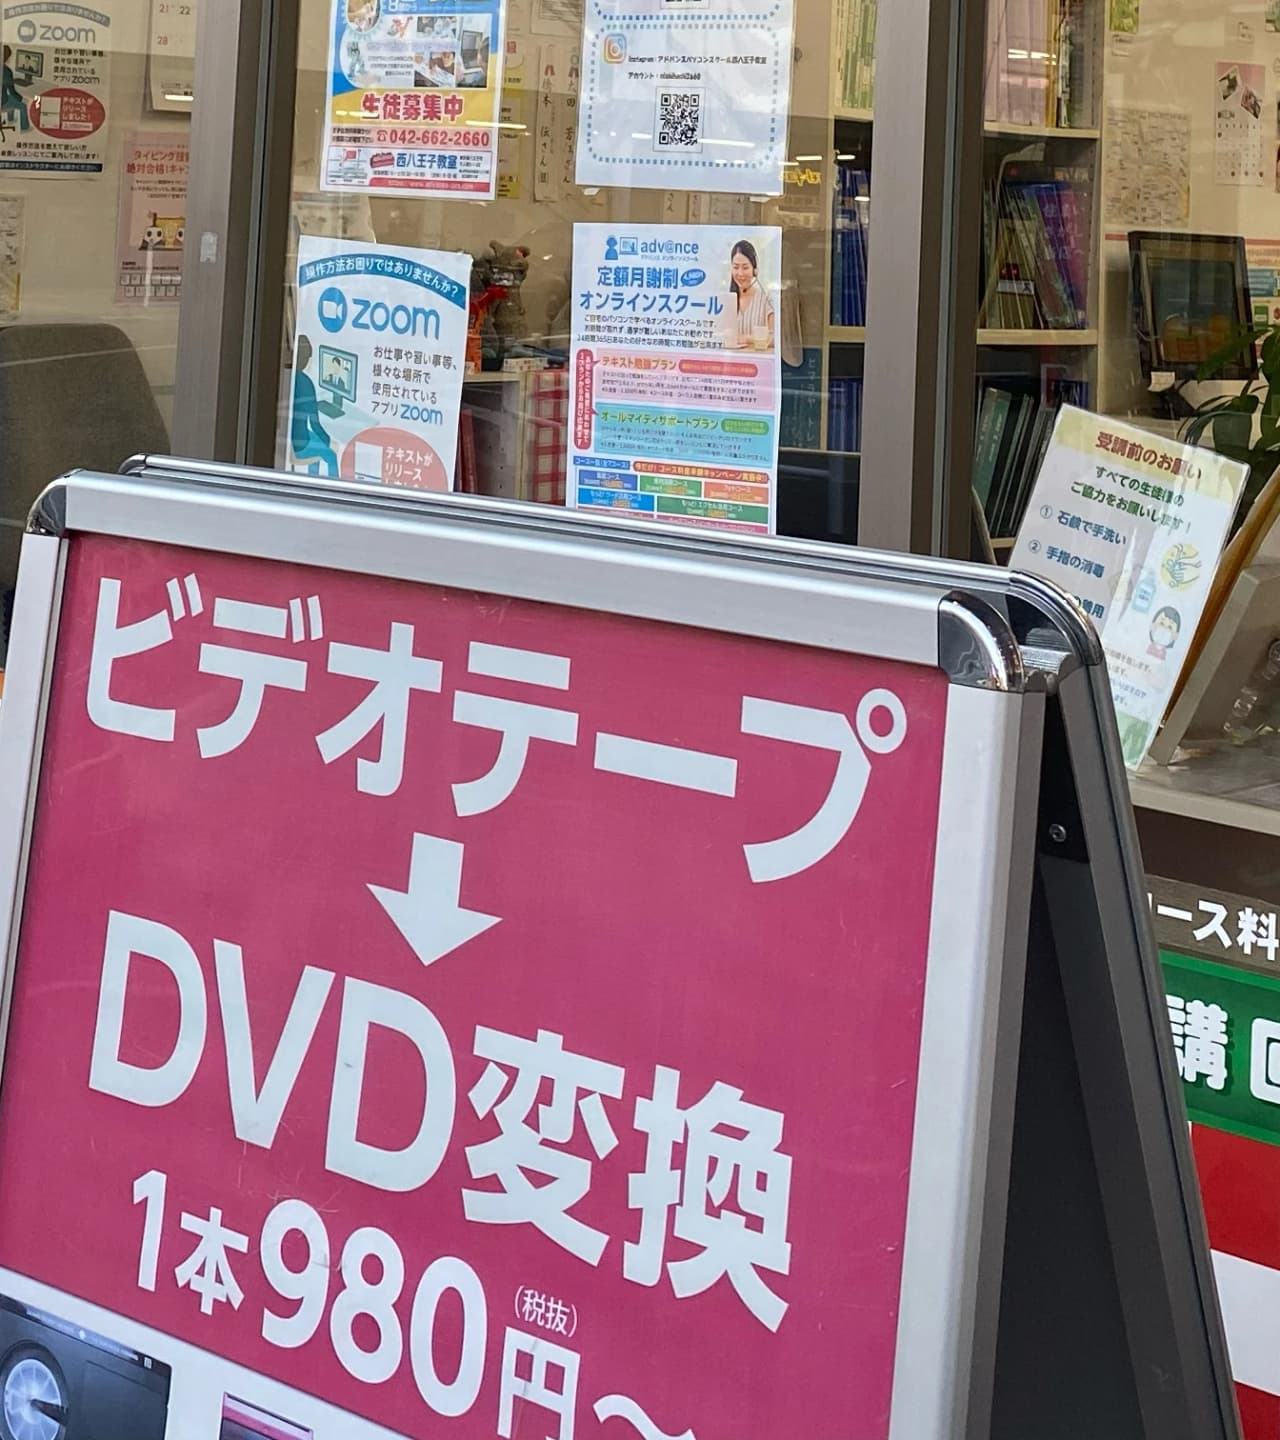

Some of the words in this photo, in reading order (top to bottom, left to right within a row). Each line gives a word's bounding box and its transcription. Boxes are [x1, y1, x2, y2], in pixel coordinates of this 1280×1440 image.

[40, 24, 96, 44] zoom
[362, 92, 464, 121] 生徒募集中
[389, 128, 490, 147] 042-662-2660
[396, 152, 458, 170] 西八王子教室
[640, 239, 700, 255] adv@nce
[304, 257, 460, 298] 操作方法お困りではありませんか?
[597, 265, 679, 289] 定額月謝制
[579, 290, 724, 315] オンラインスクール
[351, 297, 441, 341] zoom
[373, 346, 457, 372] お仕事や習い事等、
[372, 366, 432, 386] 様々な場所で
[371, 382, 438, 405] 使用されている
[600, 411, 719, 430] オールマイティサポートプラン
[385, 446, 434, 467] テキストが
[1095, 430, 1203, 481] 受講前のお願い
[385, 461, 422, 480] リリース
[1095, 464, 1185, 508] すべての生徒様の
[1057, 509, 1127, 547] 石鹸で手洗い
[1045, 545, 1106, 579] 手指の消毒
[86, 573, 907, 883] ビデオテープ
[88, 911, 793, 1332] DVD変換
[513, 1283, 579, 1338] (税抜)
